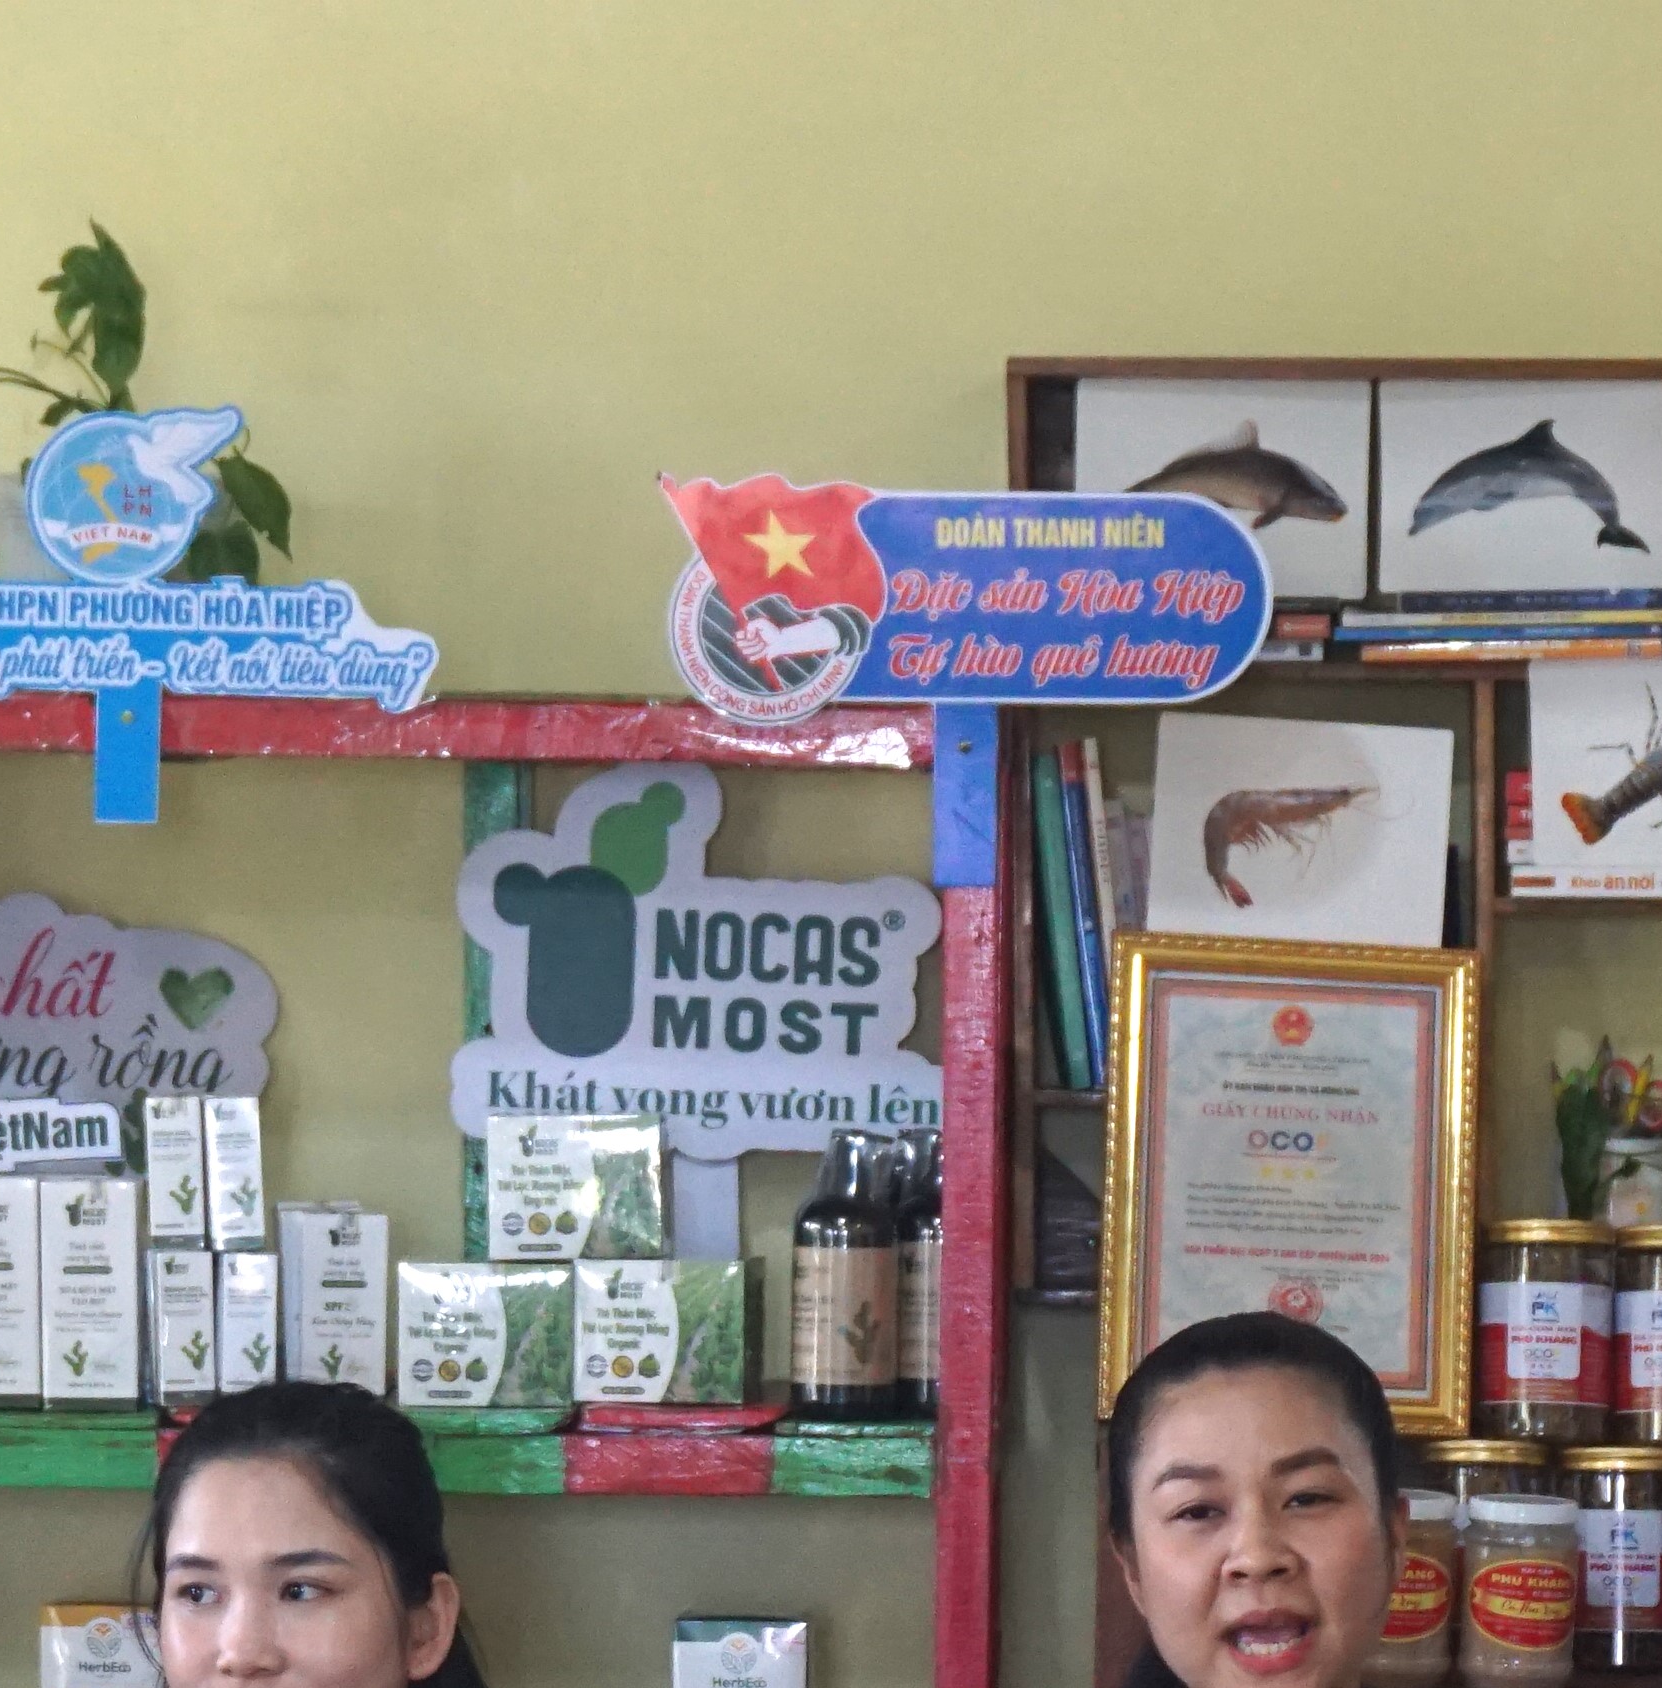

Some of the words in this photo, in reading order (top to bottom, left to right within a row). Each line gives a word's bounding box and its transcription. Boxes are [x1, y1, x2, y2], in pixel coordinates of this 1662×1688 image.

[936, 515, 1004, 548] ĐOÀN
[1014, 518, 1095, 548] THANH
[1104, 515, 1166, 548] NIÊN
[68, 586, 193, 626] PHƯỜNG
[204, 584, 265, 627] HÒA
[274, 589, 342, 636] HIỆP
[891, 569, 970, 622] Đặc
[982, 566, 1047, 615] sản
[1059, 569, 1144, 615] Hòa
[1152, 571, 1245, 626] Hiệp
[2, 640, 62, 692] phát
[72, 640, 135, 680] triển
[174, 642, 215, 683] Kết
[232, 642, 271, 683] nối
[281, 648, 330, 683] tiêu
[888, 633, 947, 685] Tự
[954, 636, 1022, 680] hào
[1032, 636, 1103, 688] quê
[1106, 639, 1219, 691] hương
[654, 908, 881, 987] NOCAS
[90, 1013, 235, 1095] rồng
[652, 995, 879, 1057] MOST
[488, 1068, 602, 1112] Khát
[740, 1088, 855, 1123] vươn
[869, 1084, 940, 1125] lên
